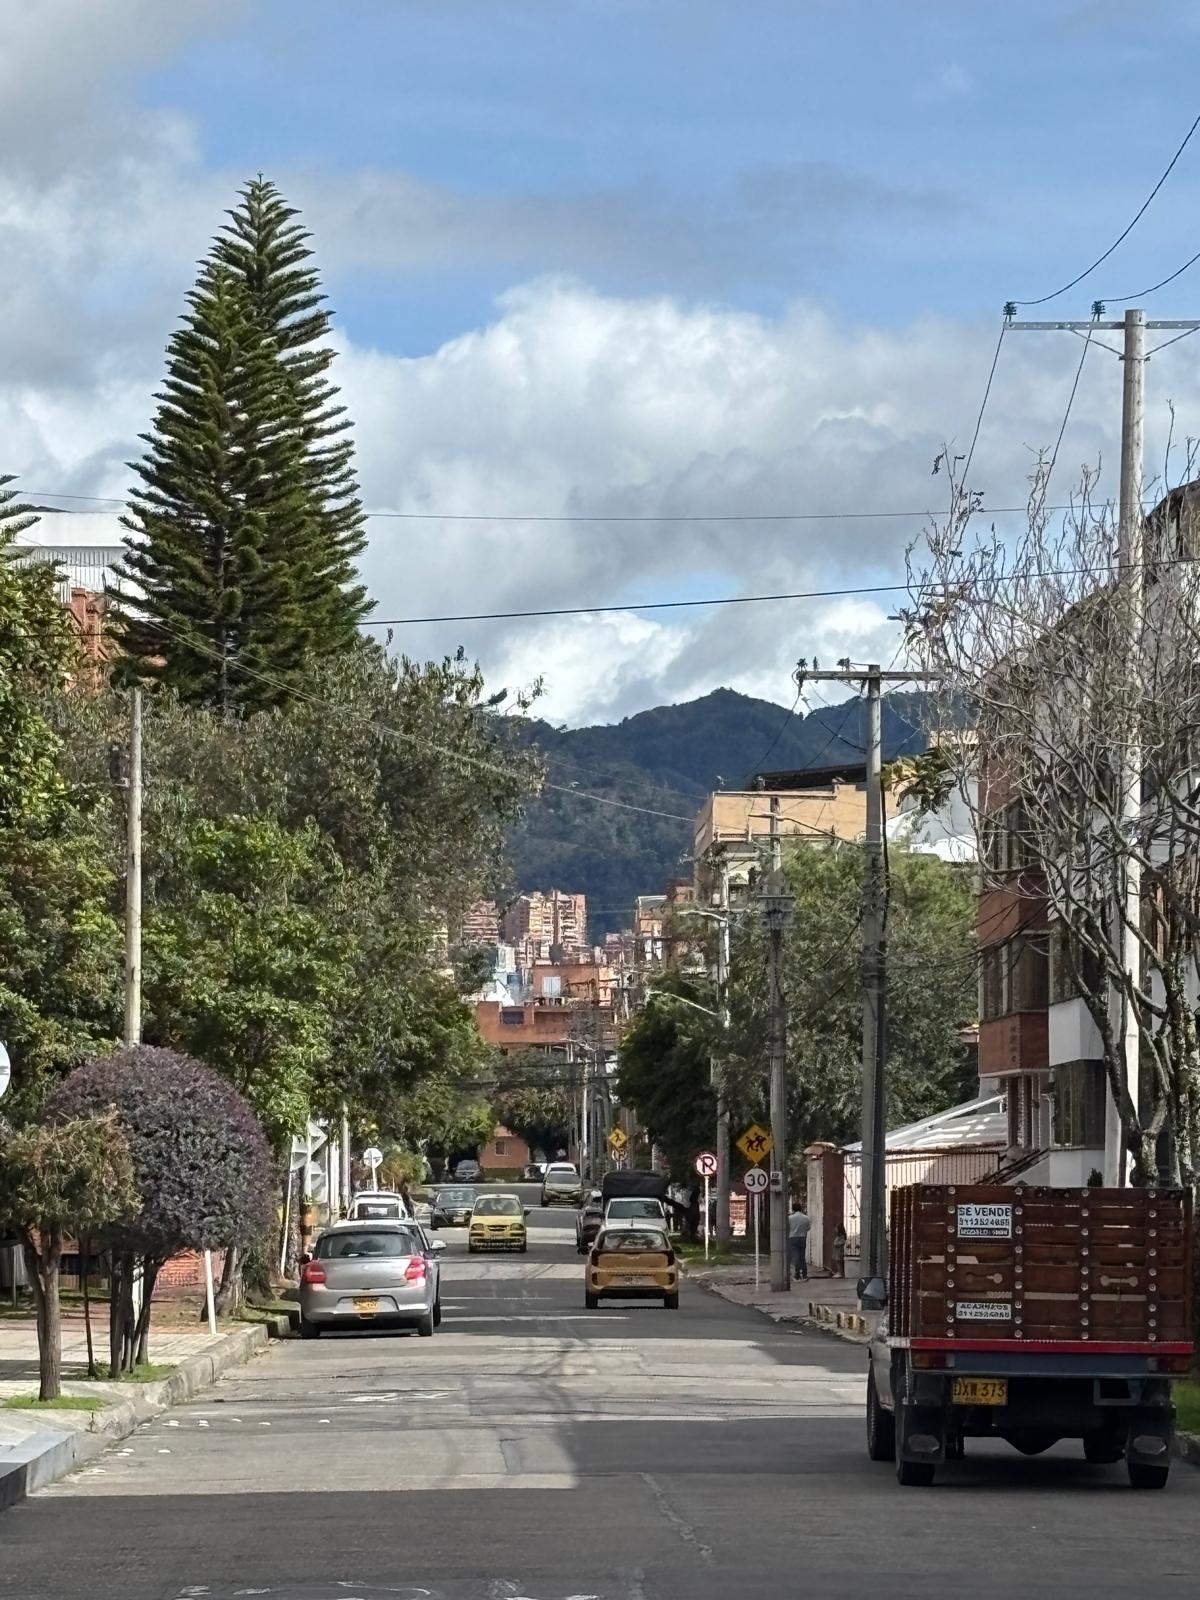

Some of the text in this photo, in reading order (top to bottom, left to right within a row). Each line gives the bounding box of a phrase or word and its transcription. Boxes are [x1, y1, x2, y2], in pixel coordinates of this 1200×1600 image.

[747, 1174, 767, 1187] 30
[959, 1206, 1011, 1217] SE VENDE
